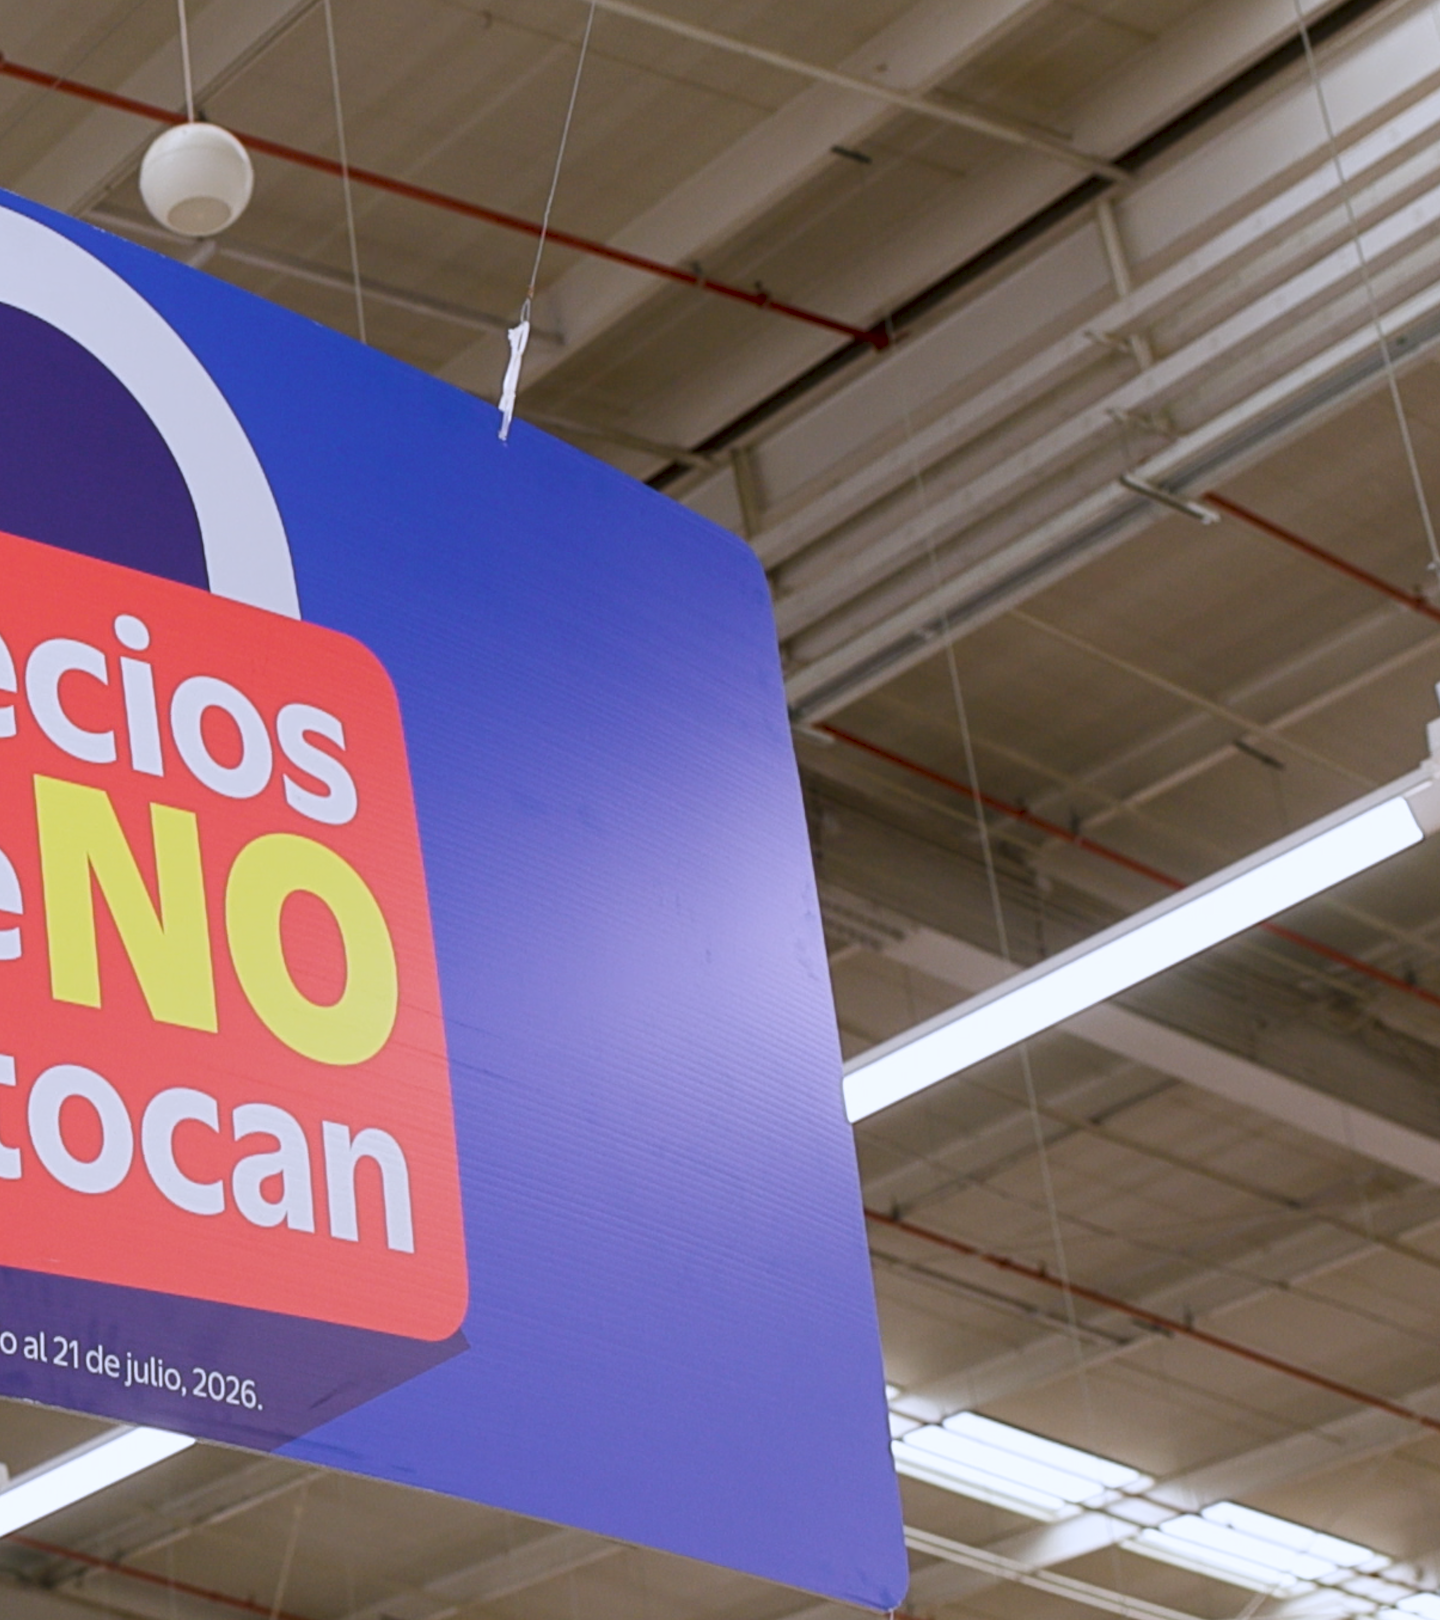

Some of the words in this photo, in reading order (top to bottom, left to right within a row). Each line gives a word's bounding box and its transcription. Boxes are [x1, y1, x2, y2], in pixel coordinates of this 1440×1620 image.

[32, 773, 400, 1067] NO
[23, 1331, 49, 1363] al
[53, 1335, 80, 1369] 21
[85, 1344, 122, 1378] de
[124, 1351, 188, 1397] julio,
[191, 1367, 265, 1411] 2026.
